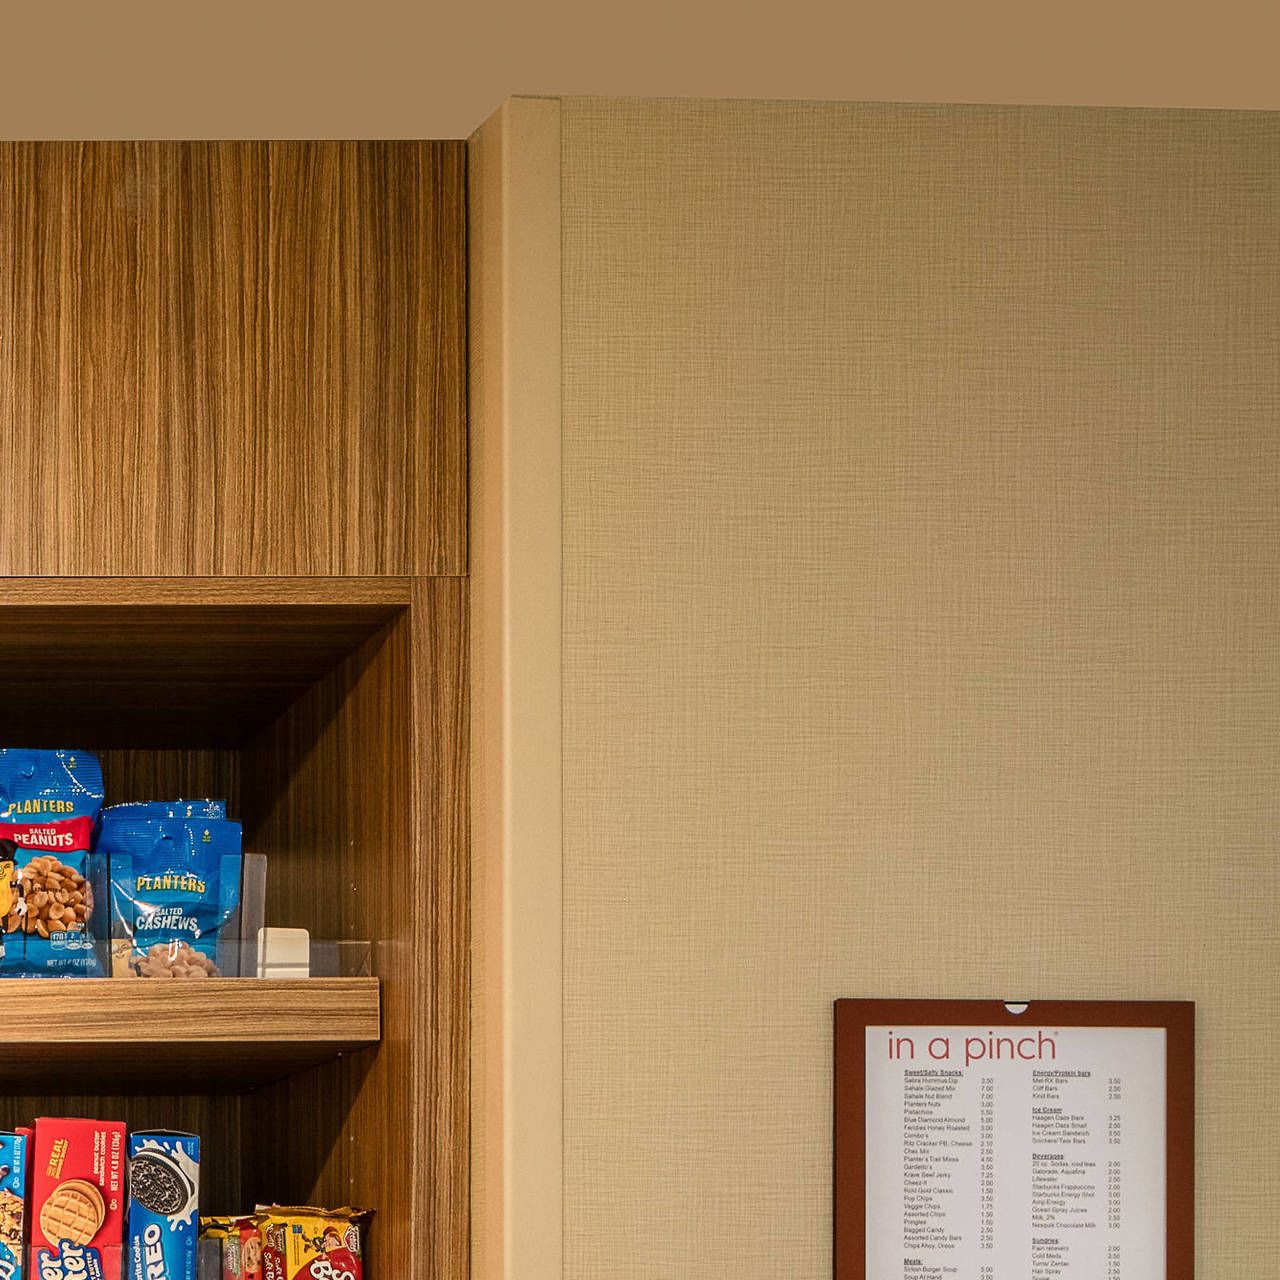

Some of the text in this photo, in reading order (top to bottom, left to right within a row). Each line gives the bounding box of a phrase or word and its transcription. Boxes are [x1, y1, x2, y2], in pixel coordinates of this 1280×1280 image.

[7, 798, 75, 816] PLANTERS
[13, 831, 75, 848] PEANUTS
[136, 874, 207, 895] PLANTERS
[136, 914, 199, 932] CASHEWS
[888, 1030, 1056, 1067] in a pinch
